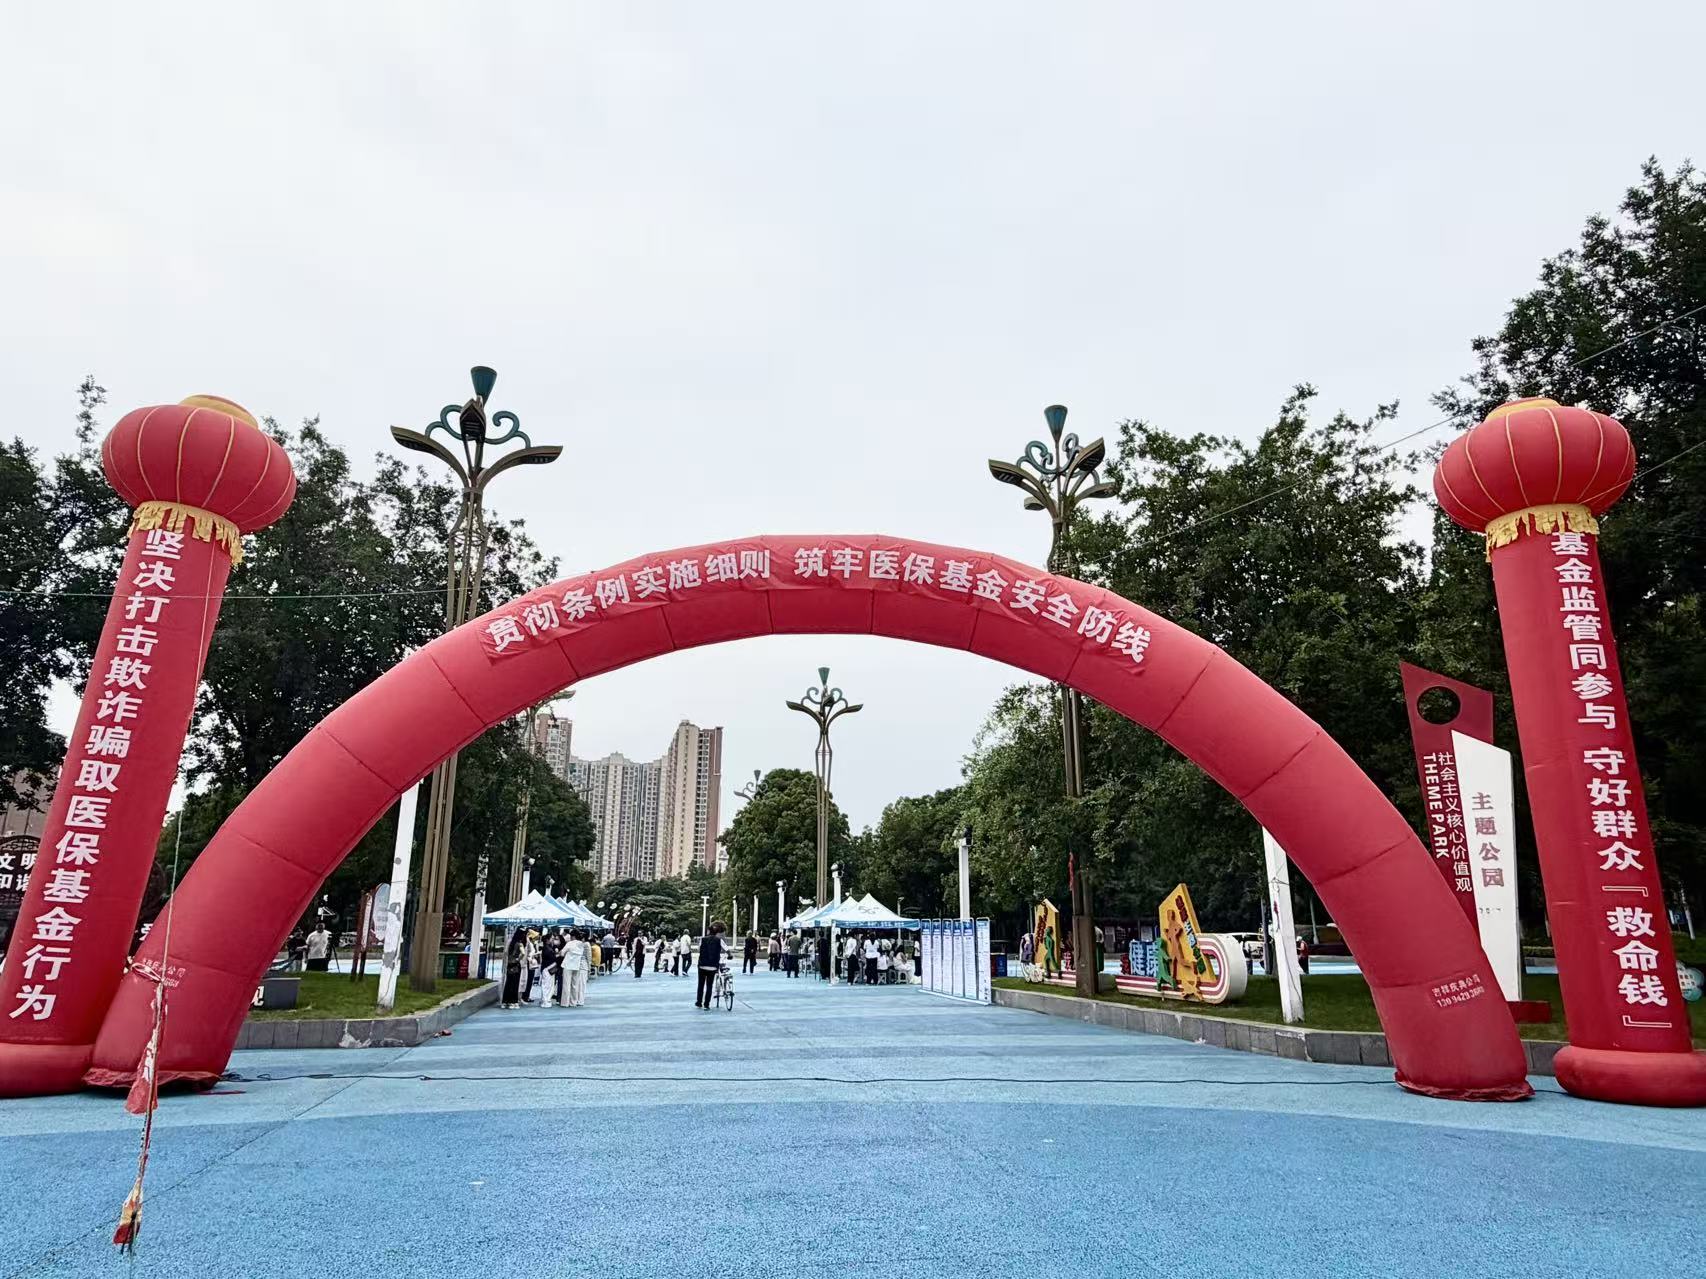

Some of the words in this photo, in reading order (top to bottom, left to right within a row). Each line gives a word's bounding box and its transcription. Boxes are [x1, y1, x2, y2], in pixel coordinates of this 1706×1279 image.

[485, 549, 771, 652] 贯彻条例实施细则
[794, 547, 1152, 663] 筑牢医保基金安全防线
[1551, 531, 1616, 729] 基金监管同参与
[9, 528, 184, 1021] 坚决打击欺诈骗取医保基金行为
[1424, 752, 1443, 810] THEME
[1438, 752, 1472, 892] 社会主义核心价值观
[1431, 813, 1449, 858] PARK
[1471, 792, 1505, 887] 主题公园
